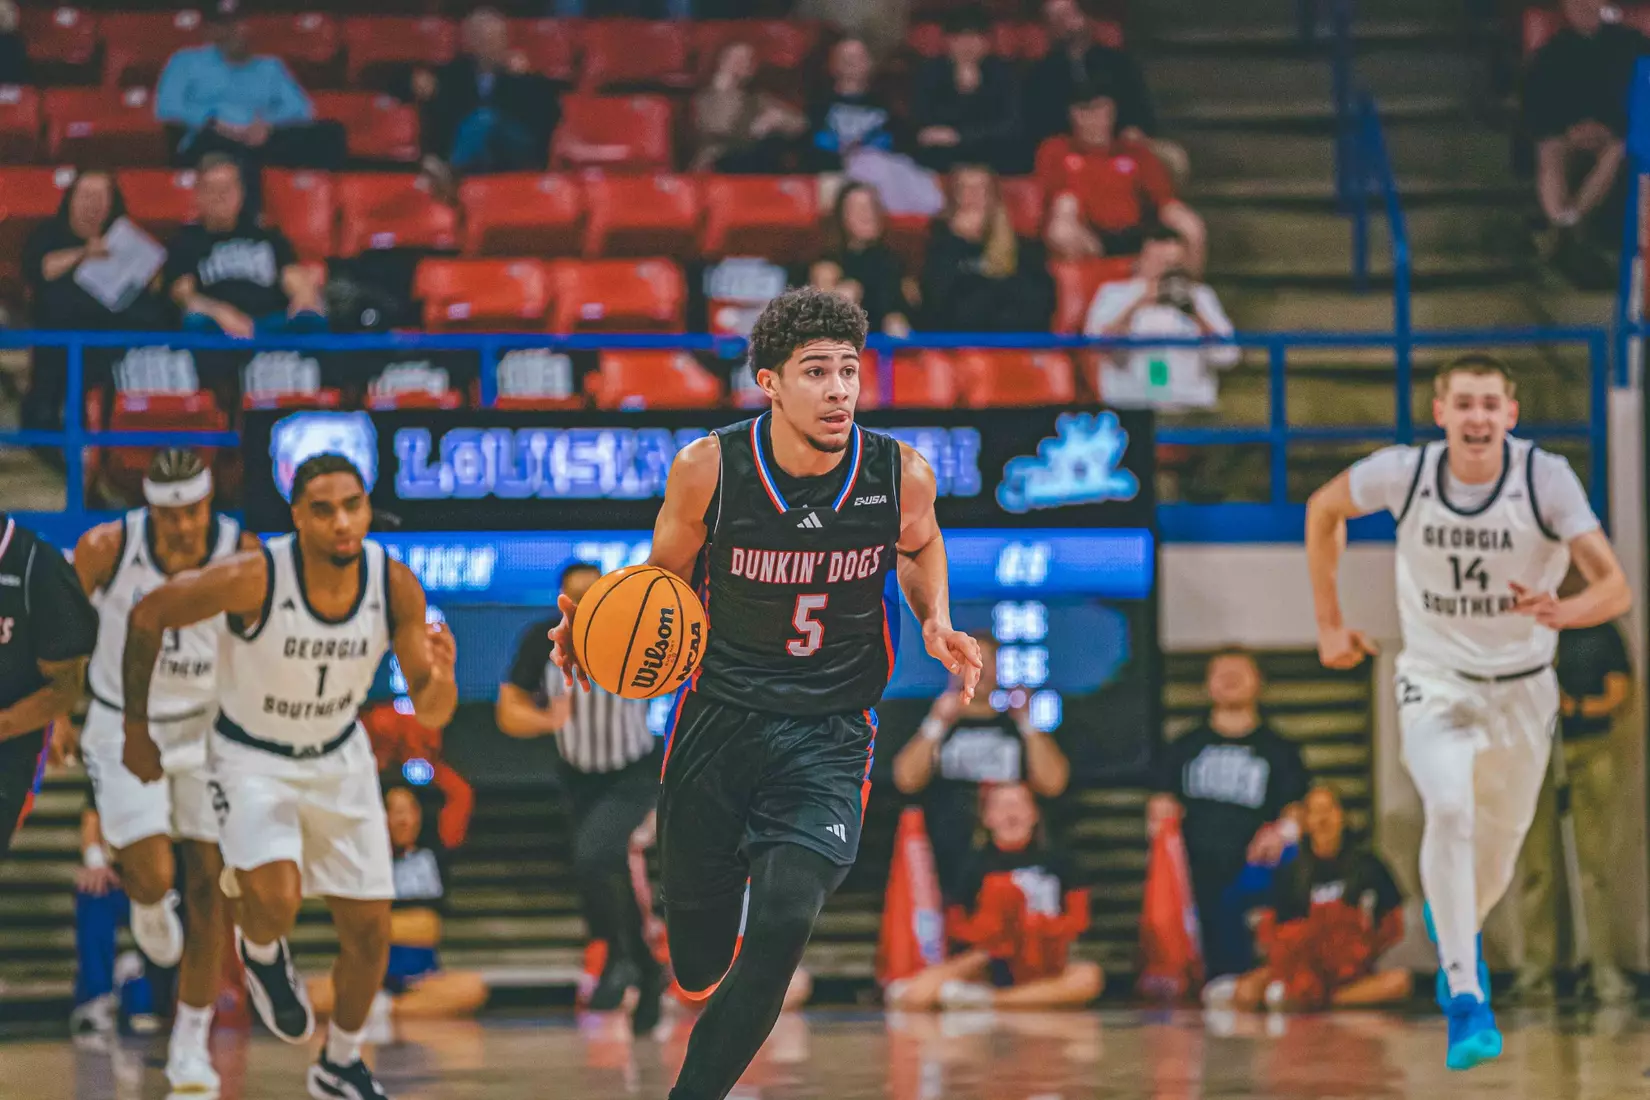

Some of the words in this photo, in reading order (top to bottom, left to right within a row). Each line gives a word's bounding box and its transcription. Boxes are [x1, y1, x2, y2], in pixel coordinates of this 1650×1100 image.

[1423, 525, 1514, 551] GEORGIA
[730, 546, 825, 584] DUNKIN'
[826, 545, 884, 584] DOGS
[1447, 554, 1489, 591] 14
[785, 593, 829, 657] 5
[283, 636, 368, 660] GEORGIA
[630, 607, 675, 689] Wilson
[676, 621, 701, 681] NCAA
[316, 664, 328, 698] 1
